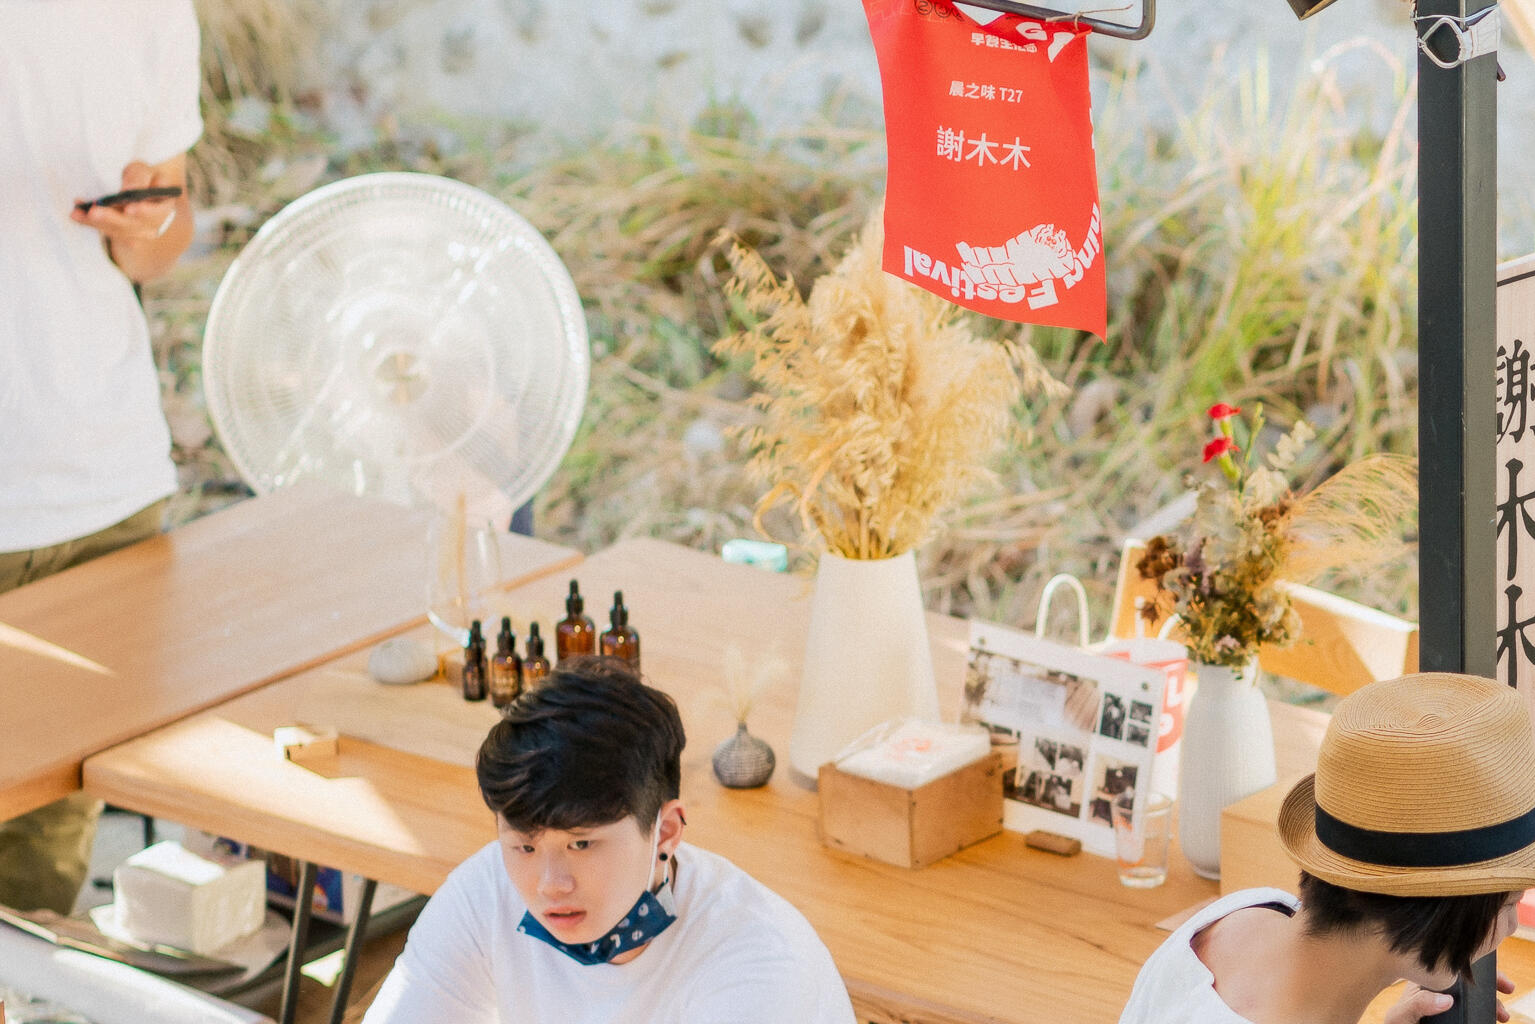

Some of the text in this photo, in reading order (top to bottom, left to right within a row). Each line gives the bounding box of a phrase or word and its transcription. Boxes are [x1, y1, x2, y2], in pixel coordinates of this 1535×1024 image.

[949, 80, 1024, 104] 晨之味 T27
[936, 126, 1031, 171] 謝木木
[902, 245, 1059, 310] Festival
